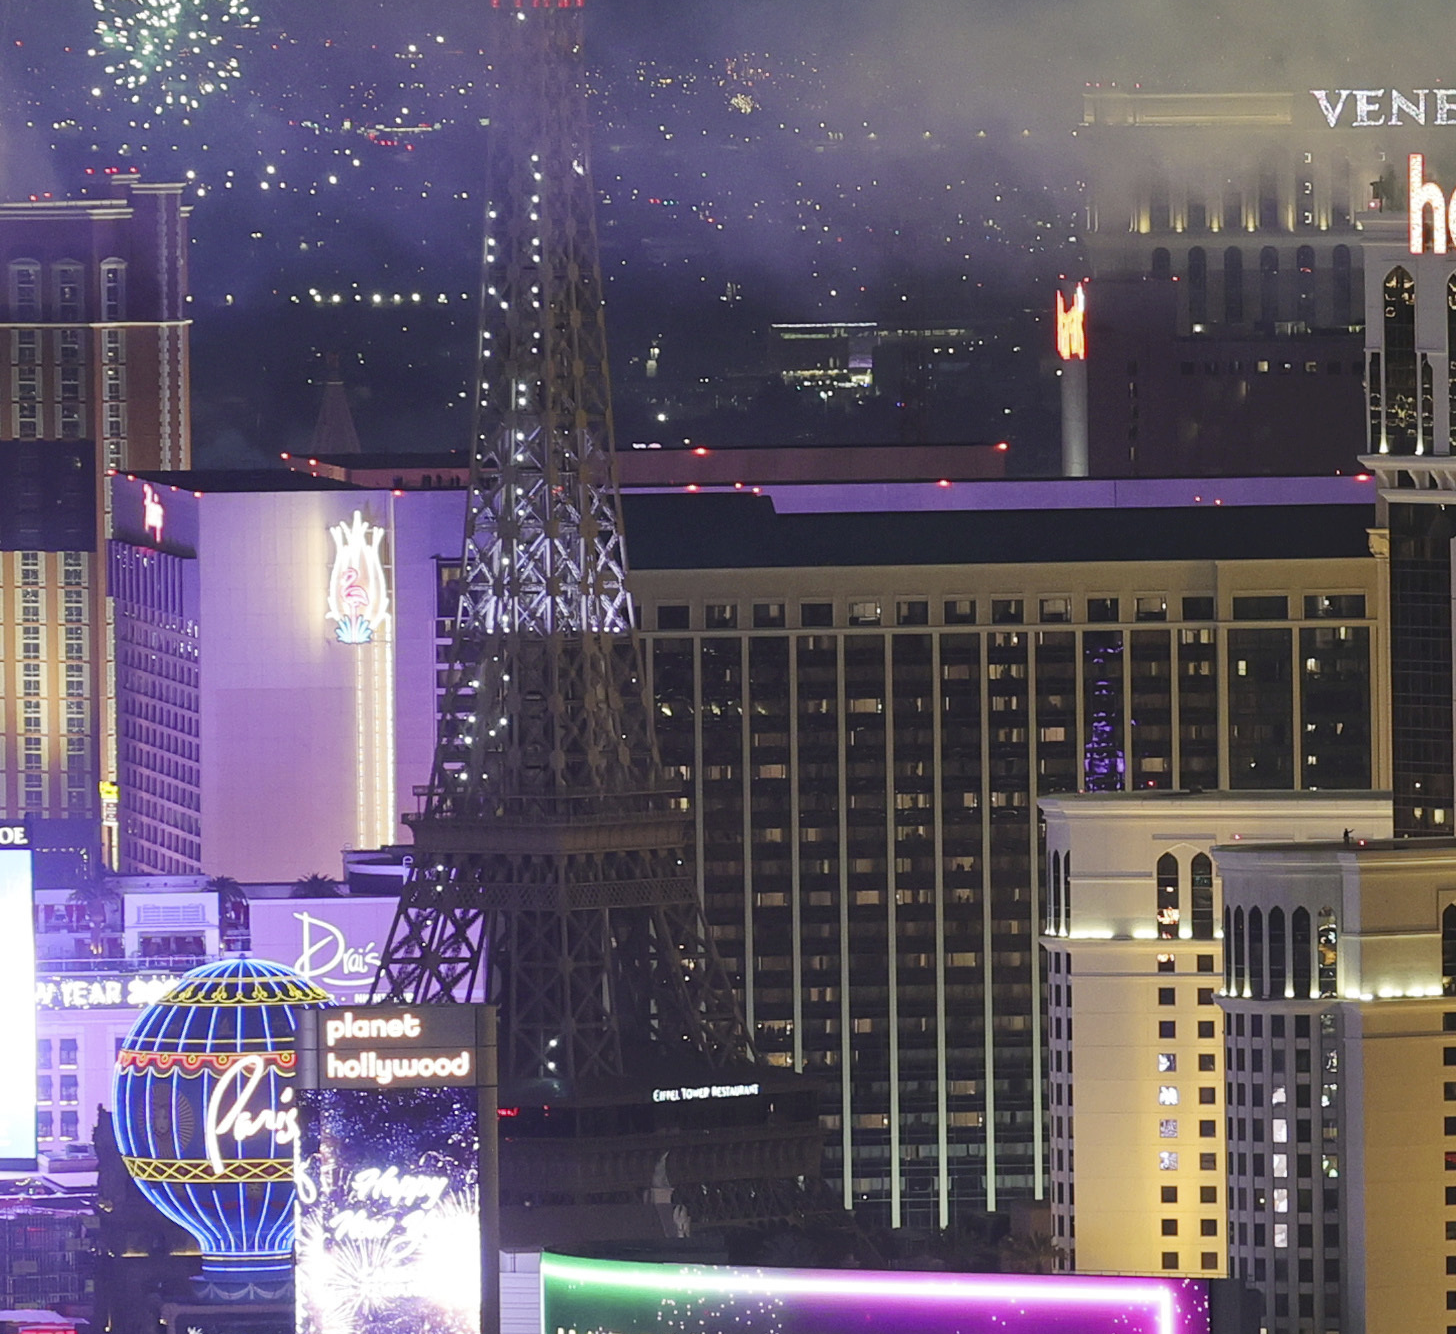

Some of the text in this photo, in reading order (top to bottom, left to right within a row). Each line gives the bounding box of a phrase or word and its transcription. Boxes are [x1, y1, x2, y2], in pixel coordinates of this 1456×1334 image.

[293, 911, 387, 985] Drai's
[61, 981, 122, 1006] YEAR
[326, 1013, 421, 1046] planet
[326, 1051, 471, 1085] hollywood
[681, 1087, 710, 1100] TOWER
[711, 1084, 759, 1097] RESTAURANT
[206, 1054, 298, 1175] Paris
